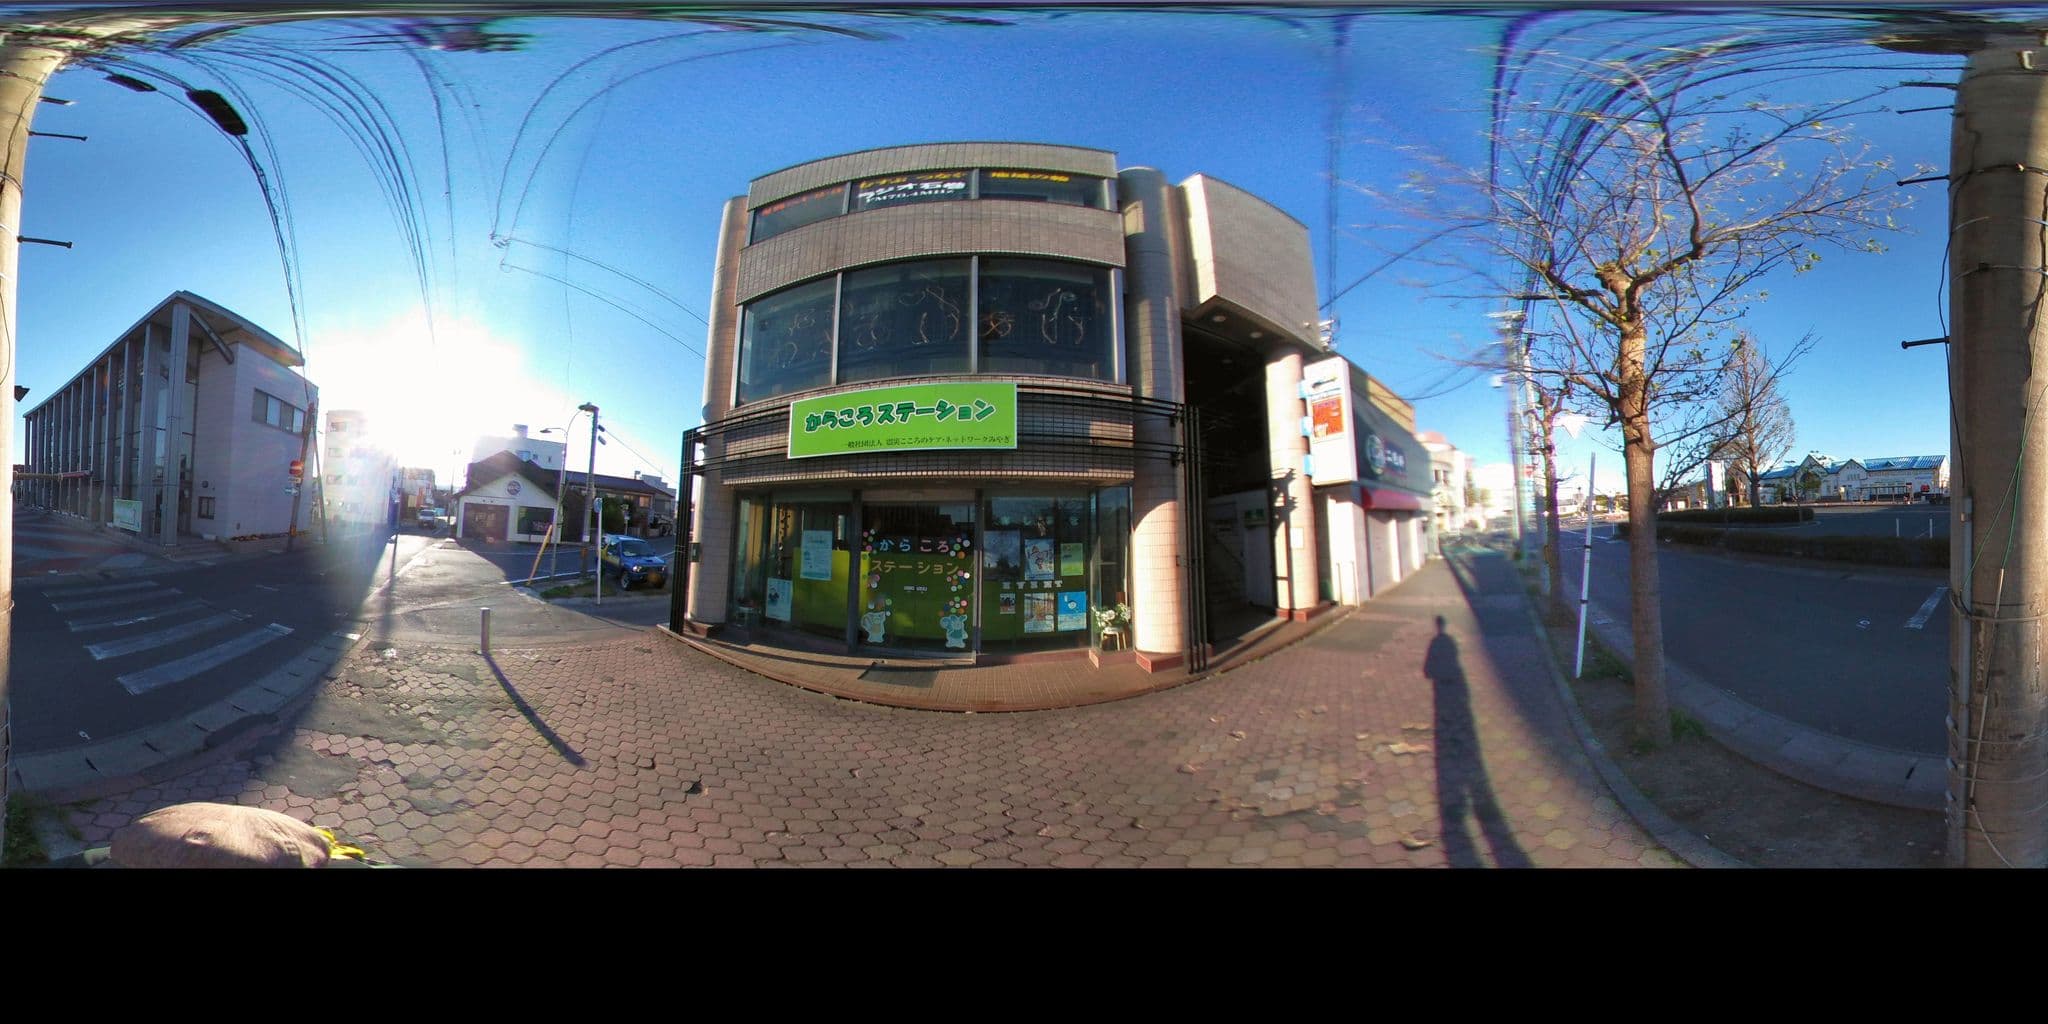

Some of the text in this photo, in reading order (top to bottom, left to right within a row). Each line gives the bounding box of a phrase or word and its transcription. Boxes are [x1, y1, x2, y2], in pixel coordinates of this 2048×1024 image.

[805, 399, 996, 434] からころステーション
[879, 539, 949, 553] からころ
[872, 560, 959, 575] ステーション
